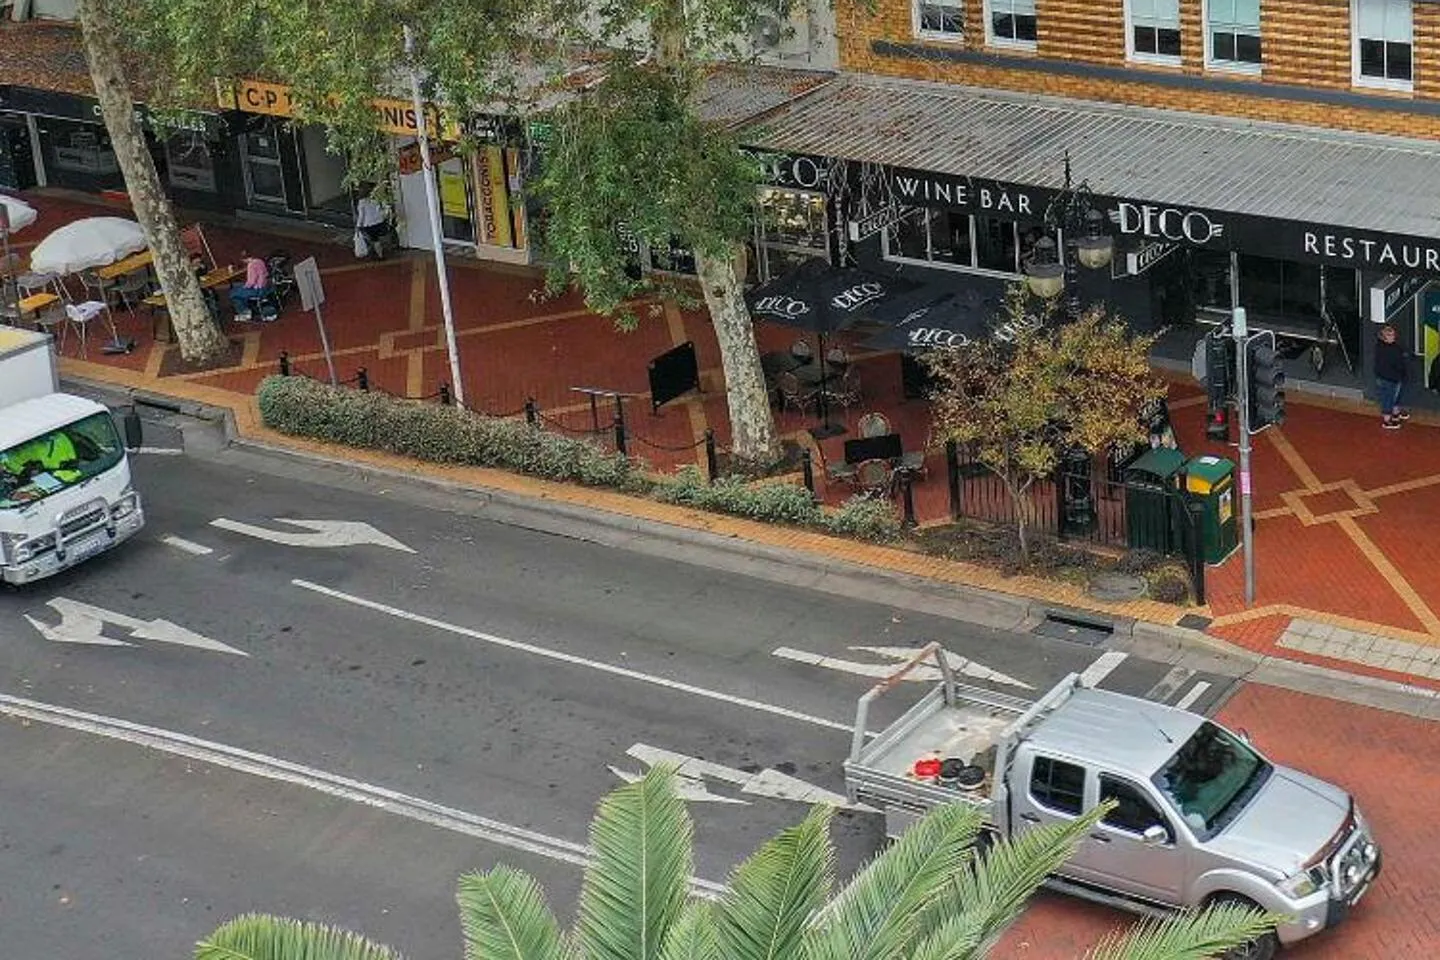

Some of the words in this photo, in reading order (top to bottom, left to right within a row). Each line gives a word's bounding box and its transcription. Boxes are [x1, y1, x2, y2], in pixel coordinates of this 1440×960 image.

[896, 176, 968, 205] WINE
[979, 189, 1032, 215] BAR
[1118, 203, 1213, 243] DECO
